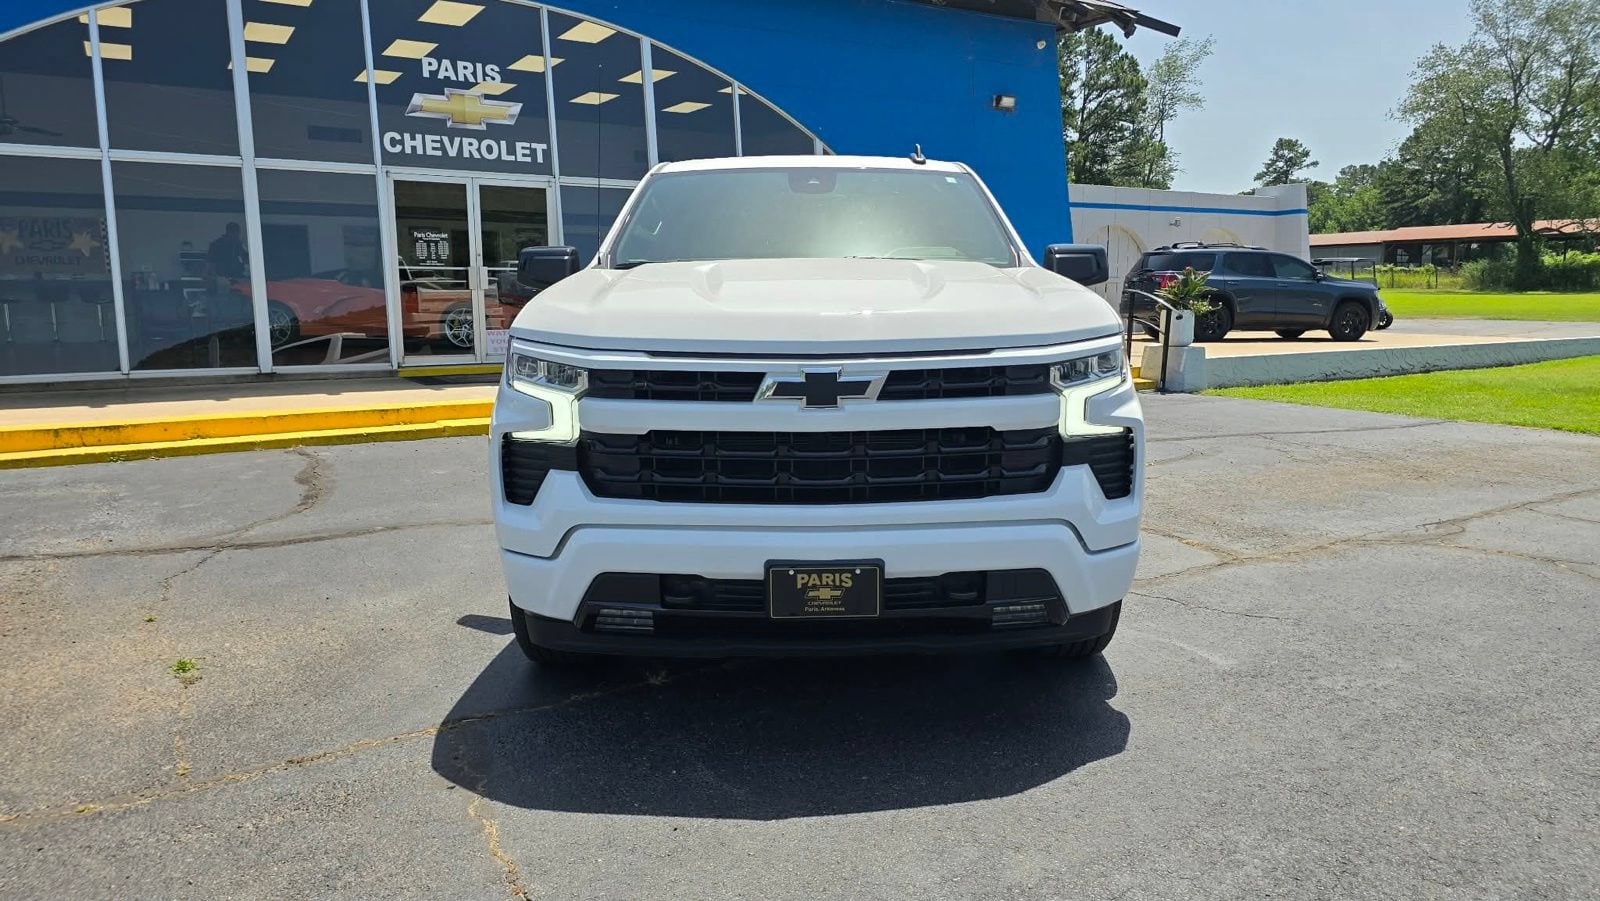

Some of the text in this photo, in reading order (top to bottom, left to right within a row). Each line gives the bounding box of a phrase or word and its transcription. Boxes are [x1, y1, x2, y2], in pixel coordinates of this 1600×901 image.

[422, 57, 502, 84] PARIS
[383, 131, 548, 163] CHEVROLET
[796, 573, 853, 589] PARIS
